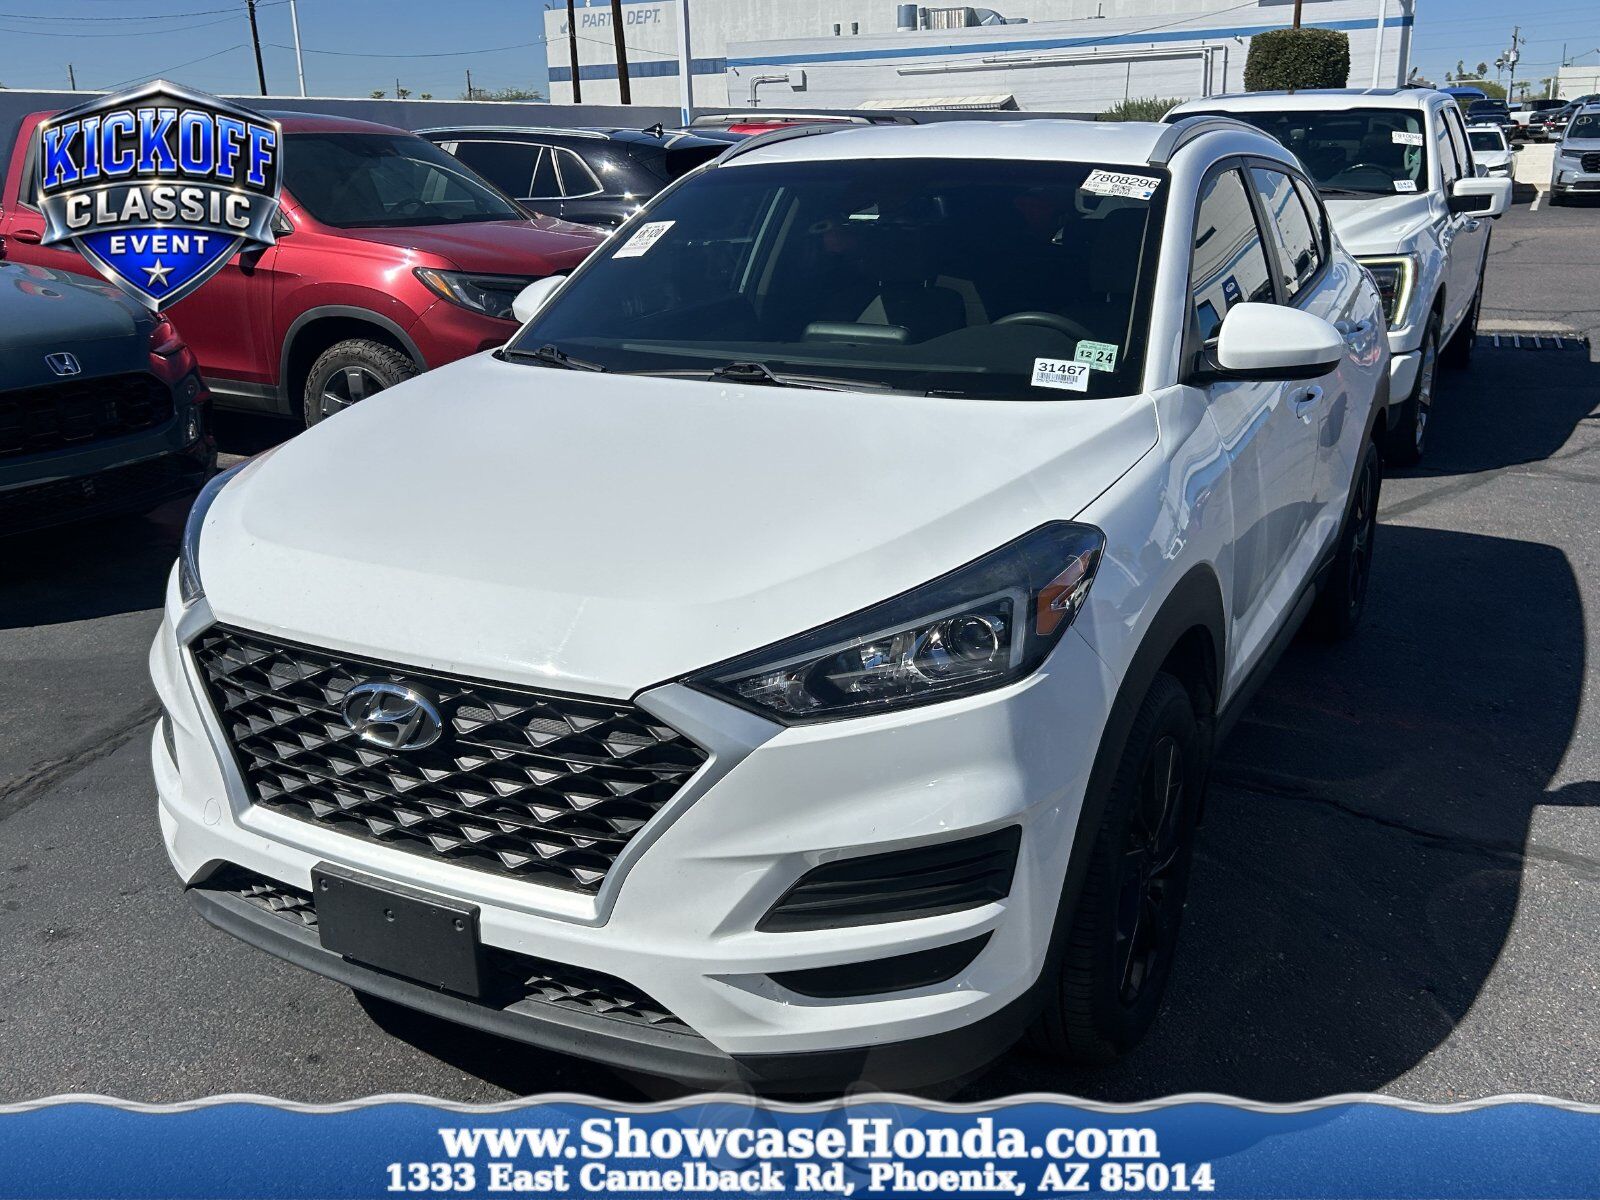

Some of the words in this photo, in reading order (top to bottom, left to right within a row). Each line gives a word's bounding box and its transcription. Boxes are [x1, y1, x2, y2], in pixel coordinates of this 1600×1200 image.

[582, 12, 613, 28] PART
[626, 8, 661, 25] DEPT.
[1091, 173, 1159, 189] 7808296
[1080, 350, 1092, 358] 12
[1096, 351, 1114, 364] 24
[1038, 362, 1087, 376] 31467
